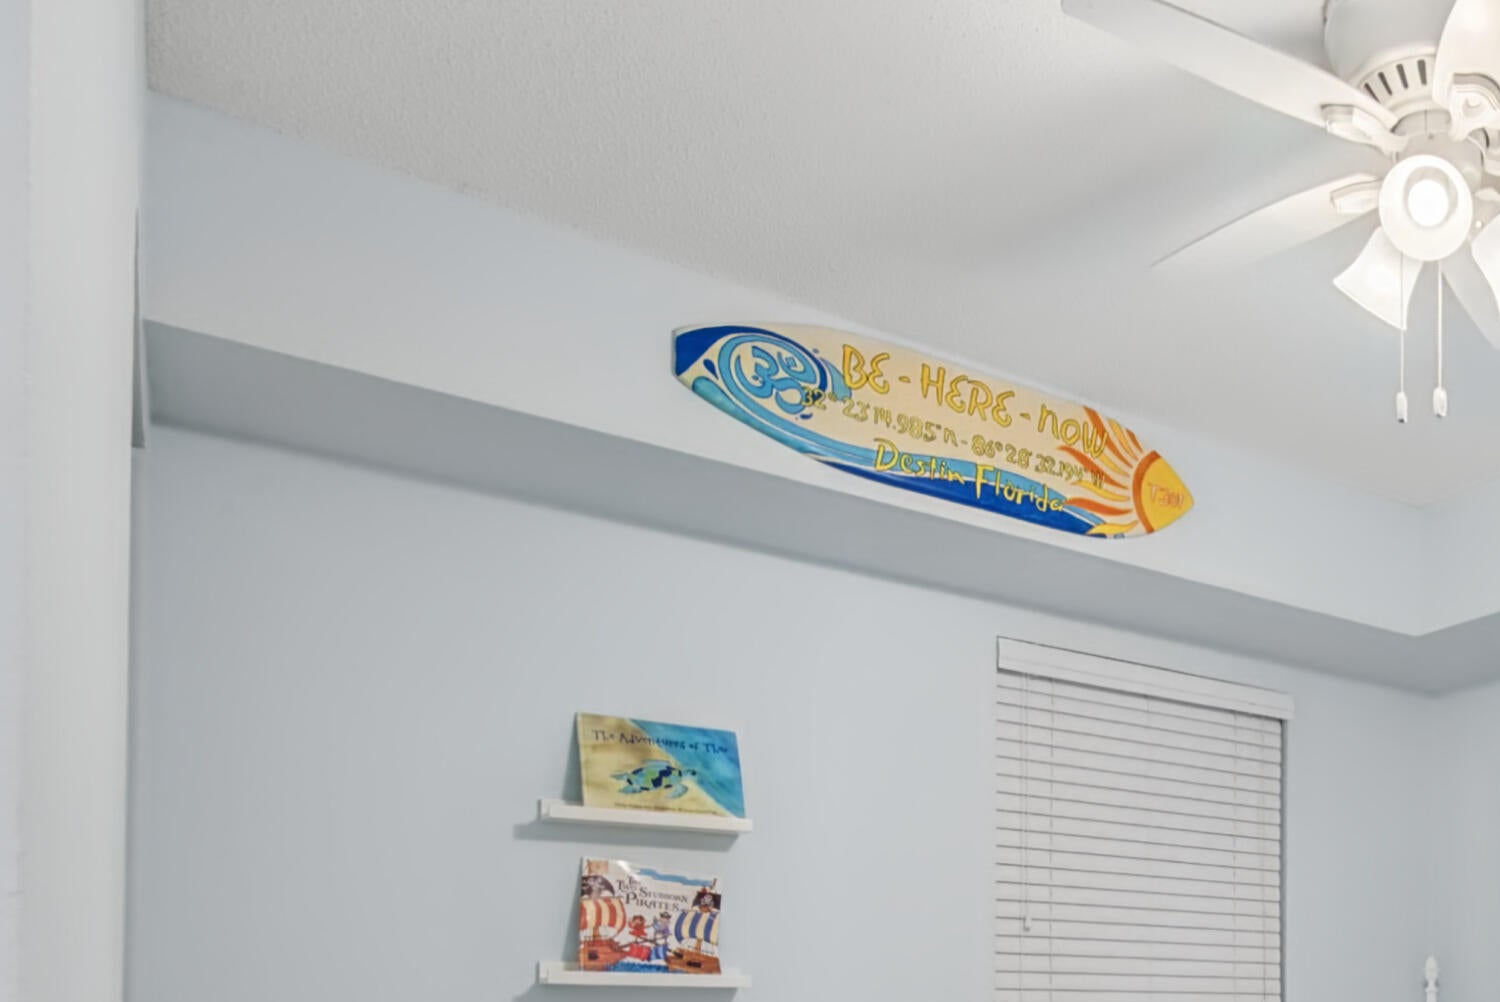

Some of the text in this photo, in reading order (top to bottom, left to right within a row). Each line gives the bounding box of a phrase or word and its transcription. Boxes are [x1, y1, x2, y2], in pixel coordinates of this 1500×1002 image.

[842, 343, 890, 395] BE
[919, 362, 1016, 429] HERE
[873, 437, 1065, 512] Destin Florida
